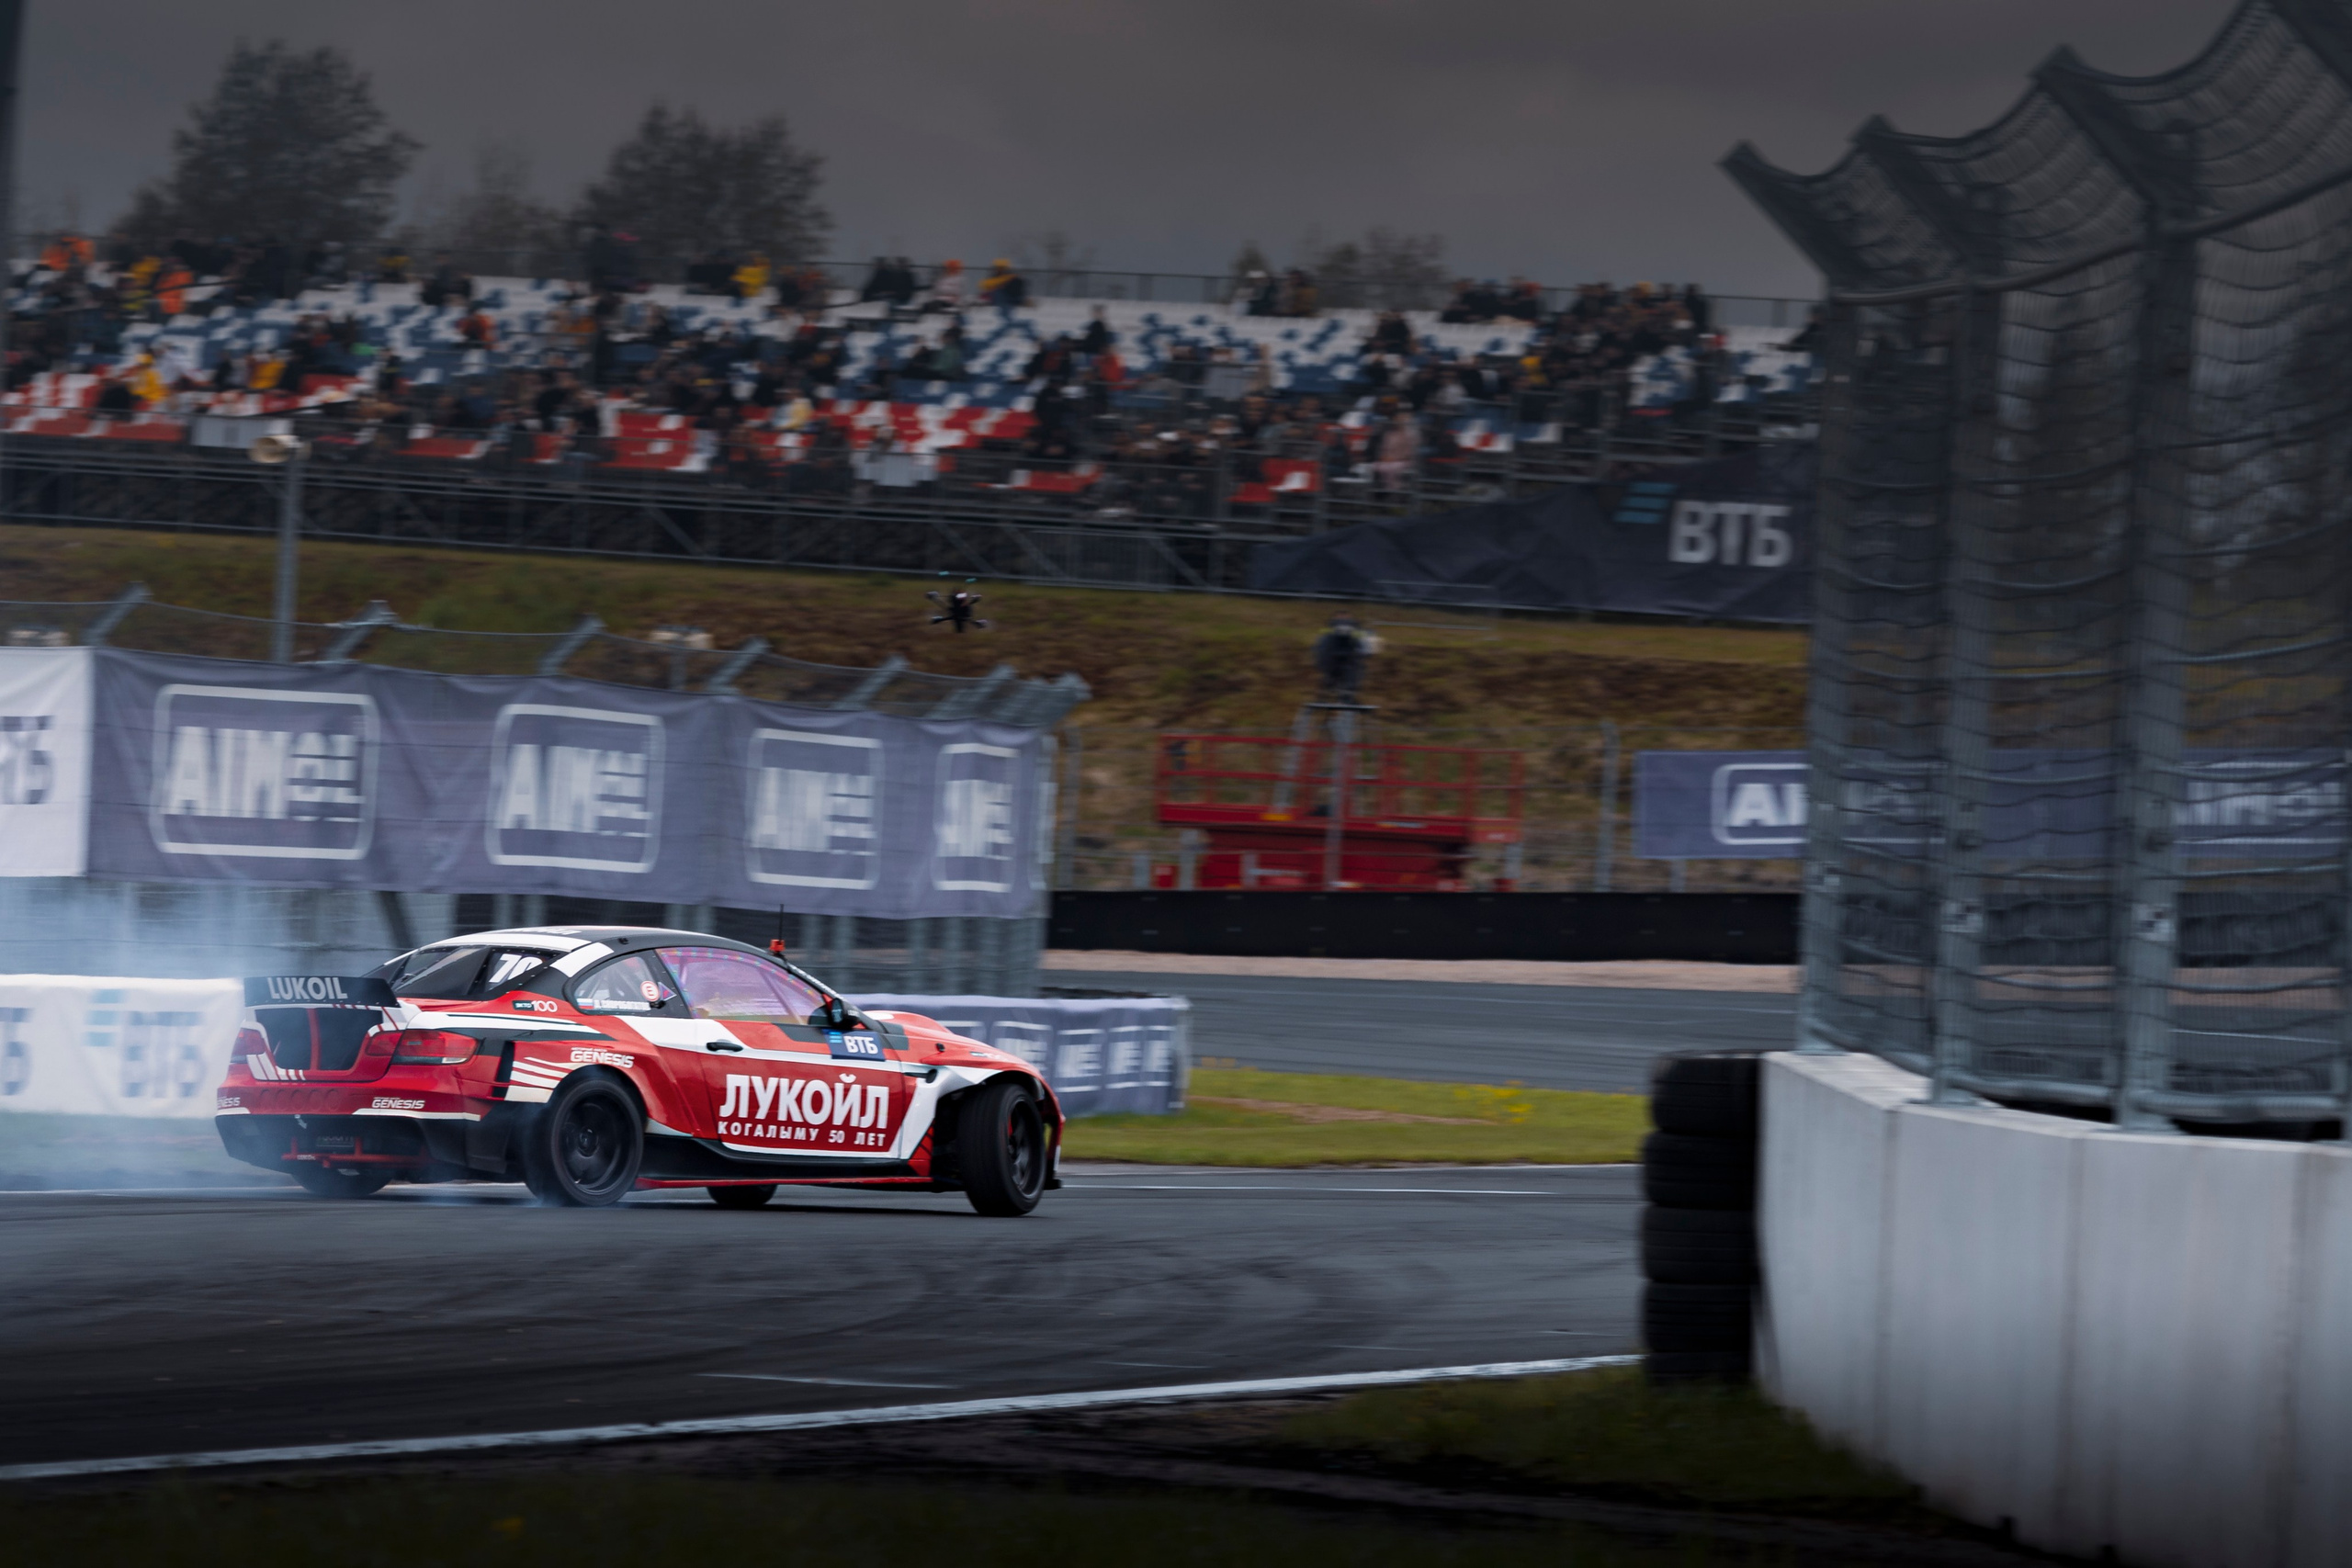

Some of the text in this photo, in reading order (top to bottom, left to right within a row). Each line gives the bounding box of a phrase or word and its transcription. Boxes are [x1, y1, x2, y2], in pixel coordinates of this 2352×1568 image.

[1668, 501, 1792, 569] ВТБ
[266, 976, 348, 1000] LUKOIL
[531, 999, 558, 1013] 100
[843, 1035, 879, 1055] ВТБ
[571, 1050, 635, 1068] GENESIS
[371, 1099, 425, 1110] GENESIS
[719, 1073, 889, 1129] ЛУКОЙЛ
[718, 1121, 887, 1147] КОГАЛЫМУ 50 ЛЕТ
